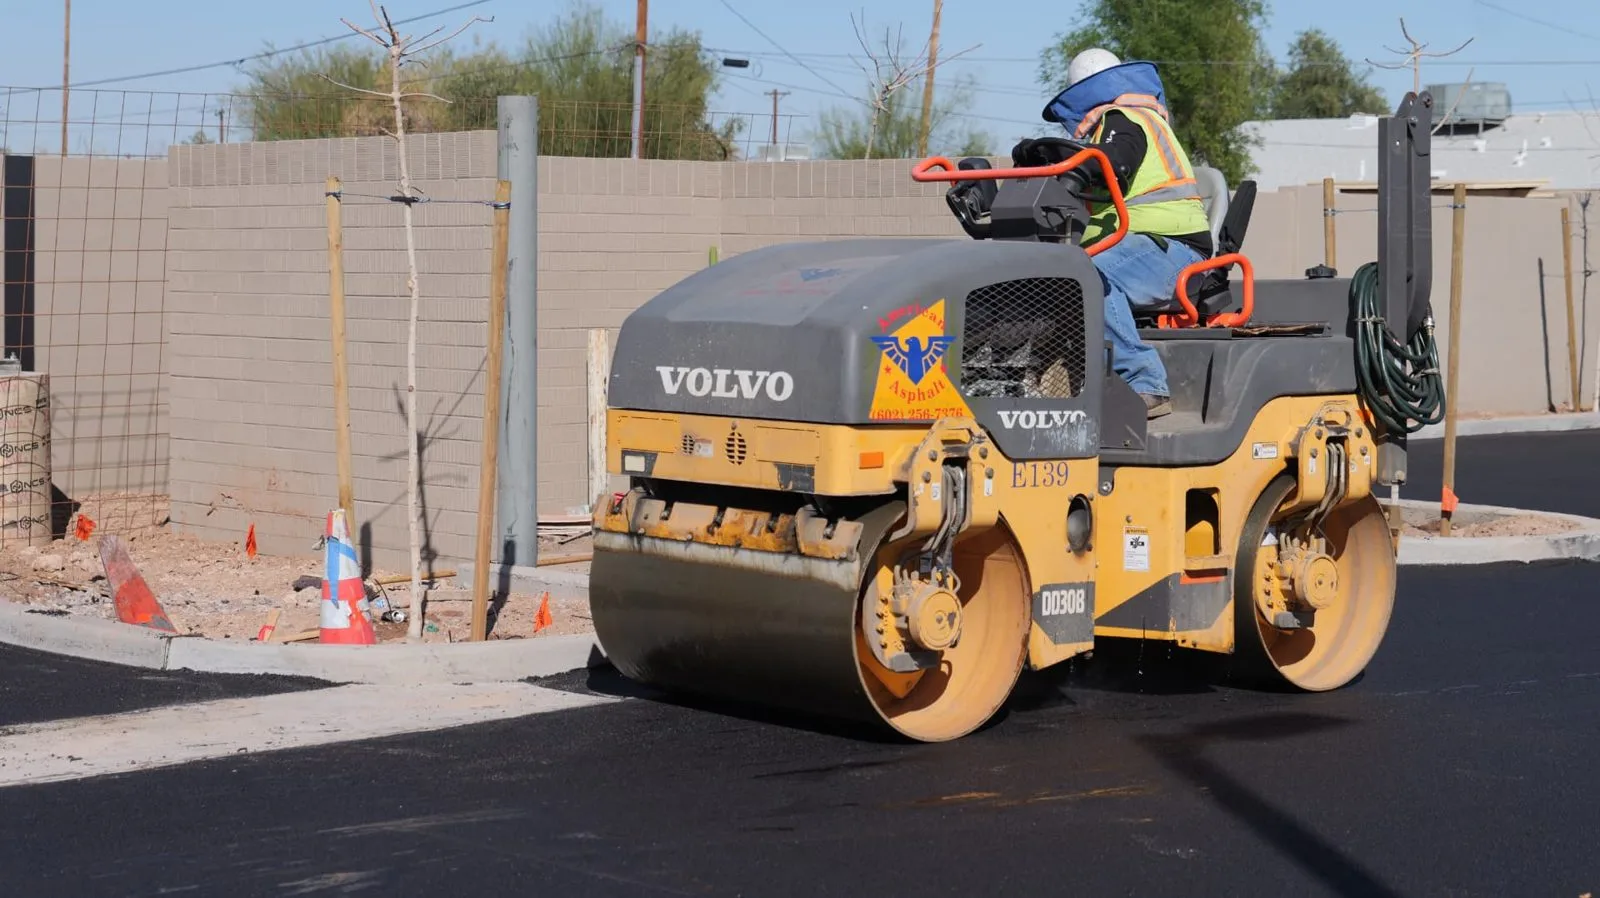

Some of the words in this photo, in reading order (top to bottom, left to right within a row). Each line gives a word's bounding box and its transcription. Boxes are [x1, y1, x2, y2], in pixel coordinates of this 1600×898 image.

[876, 304, 945, 334] American
[655, 366, 794, 401] VOLVO
[889, 379, 946, 405] Asphalt
[871, 408, 905, 420] (602)
[14, 441, 40, 453] NCS
[23, 477, 45, 489] NCS
[1011, 461, 1069, 488] E139
[1041, 588, 1085, 616] DD30B
